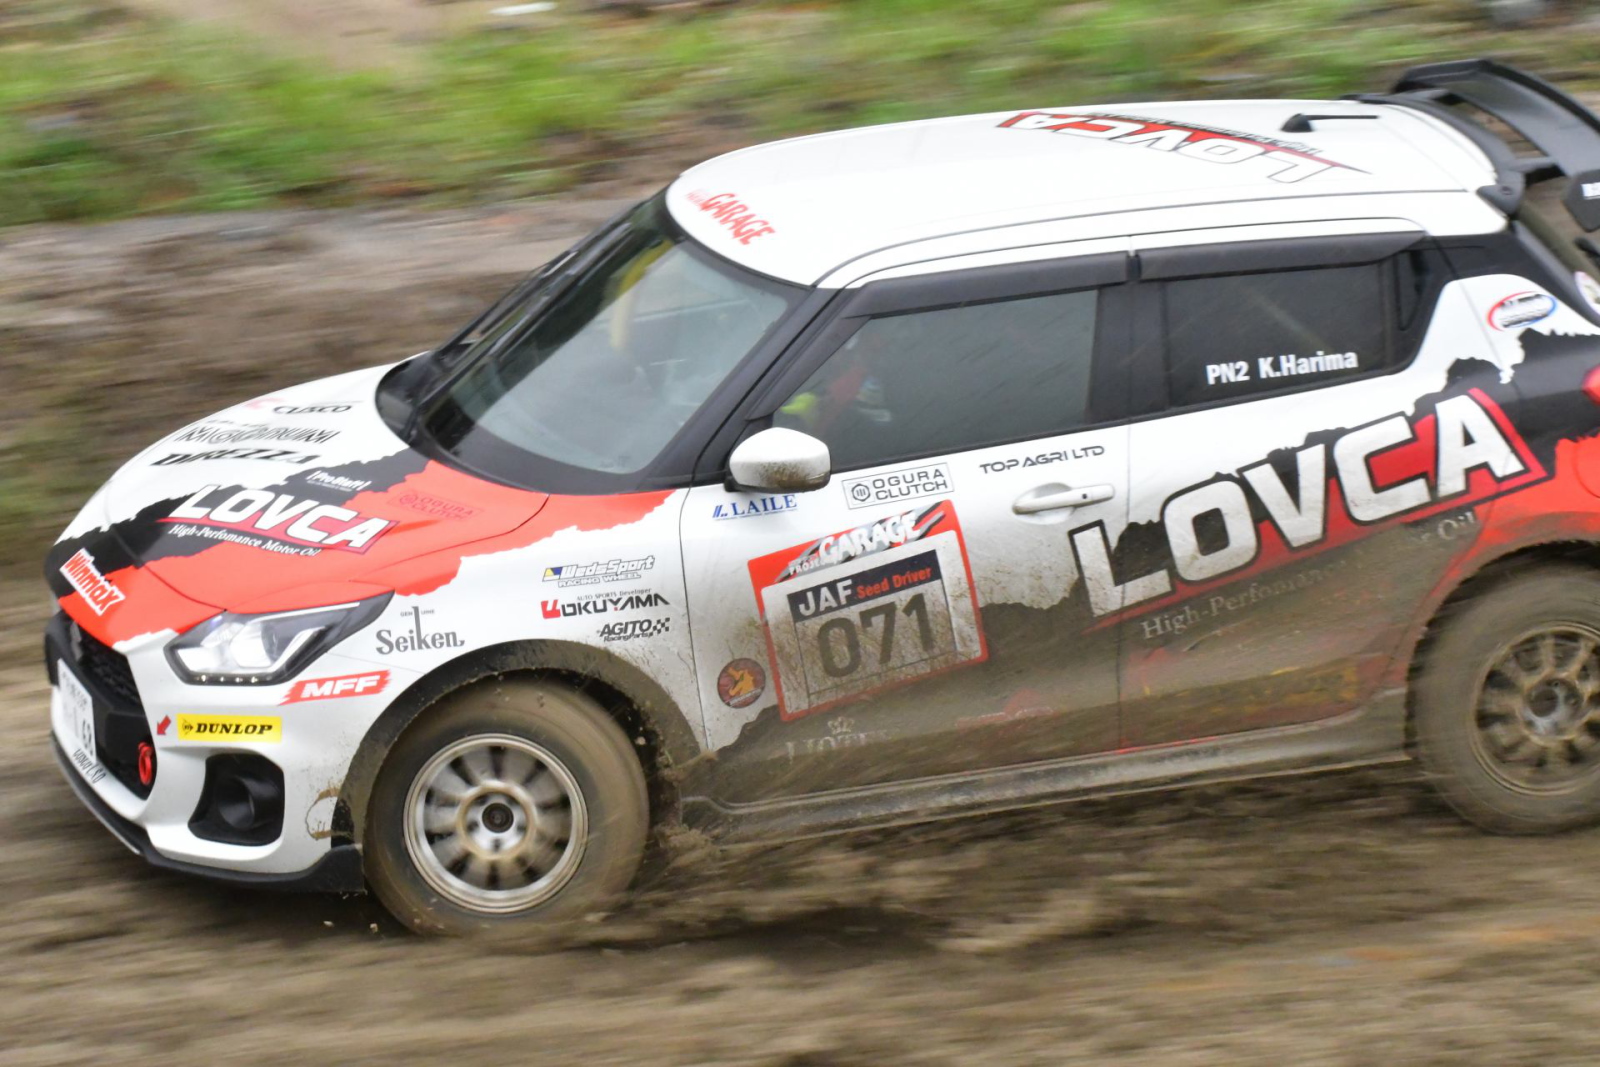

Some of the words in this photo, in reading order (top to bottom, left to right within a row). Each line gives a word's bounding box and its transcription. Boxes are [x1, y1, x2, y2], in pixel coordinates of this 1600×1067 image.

[700, 193, 776, 246] GARAGE
[1205, 360, 1250, 385] PN2
[1258, 350, 1359, 379] K.Harima
[979, 459, 1020, 474] TOP
[1022, 451, 1068, 468] AGRI
[1071, 445, 1105, 459] LTD
[872, 468, 945, 490] OGURA
[875, 479, 948, 501] CLUTCH
[168, 484, 390, 548] LOVCA
[730, 494, 798, 516] LAILE
[1074, 394, 1526, 618] LOVCA
[261, 539, 300, 555] Motor
[299, 547, 322, 557] Oil
[818, 511, 921, 563] GARAGE
[558, 577, 600, 587] RACING
[798, 579, 853, 617] JAF
[856, 577, 890, 599] Seed
[892, 566, 933, 588] Driver
[561, 593, 670, 616] OKUYAMA
[375, 605, 466, 655] Seiken
[600, 619, 652, 637] AGITO
[817, 592, 935, 678] 071
[300, 674, 381, 699] MFF
[194, 722, 274, 736] DUNLOP
